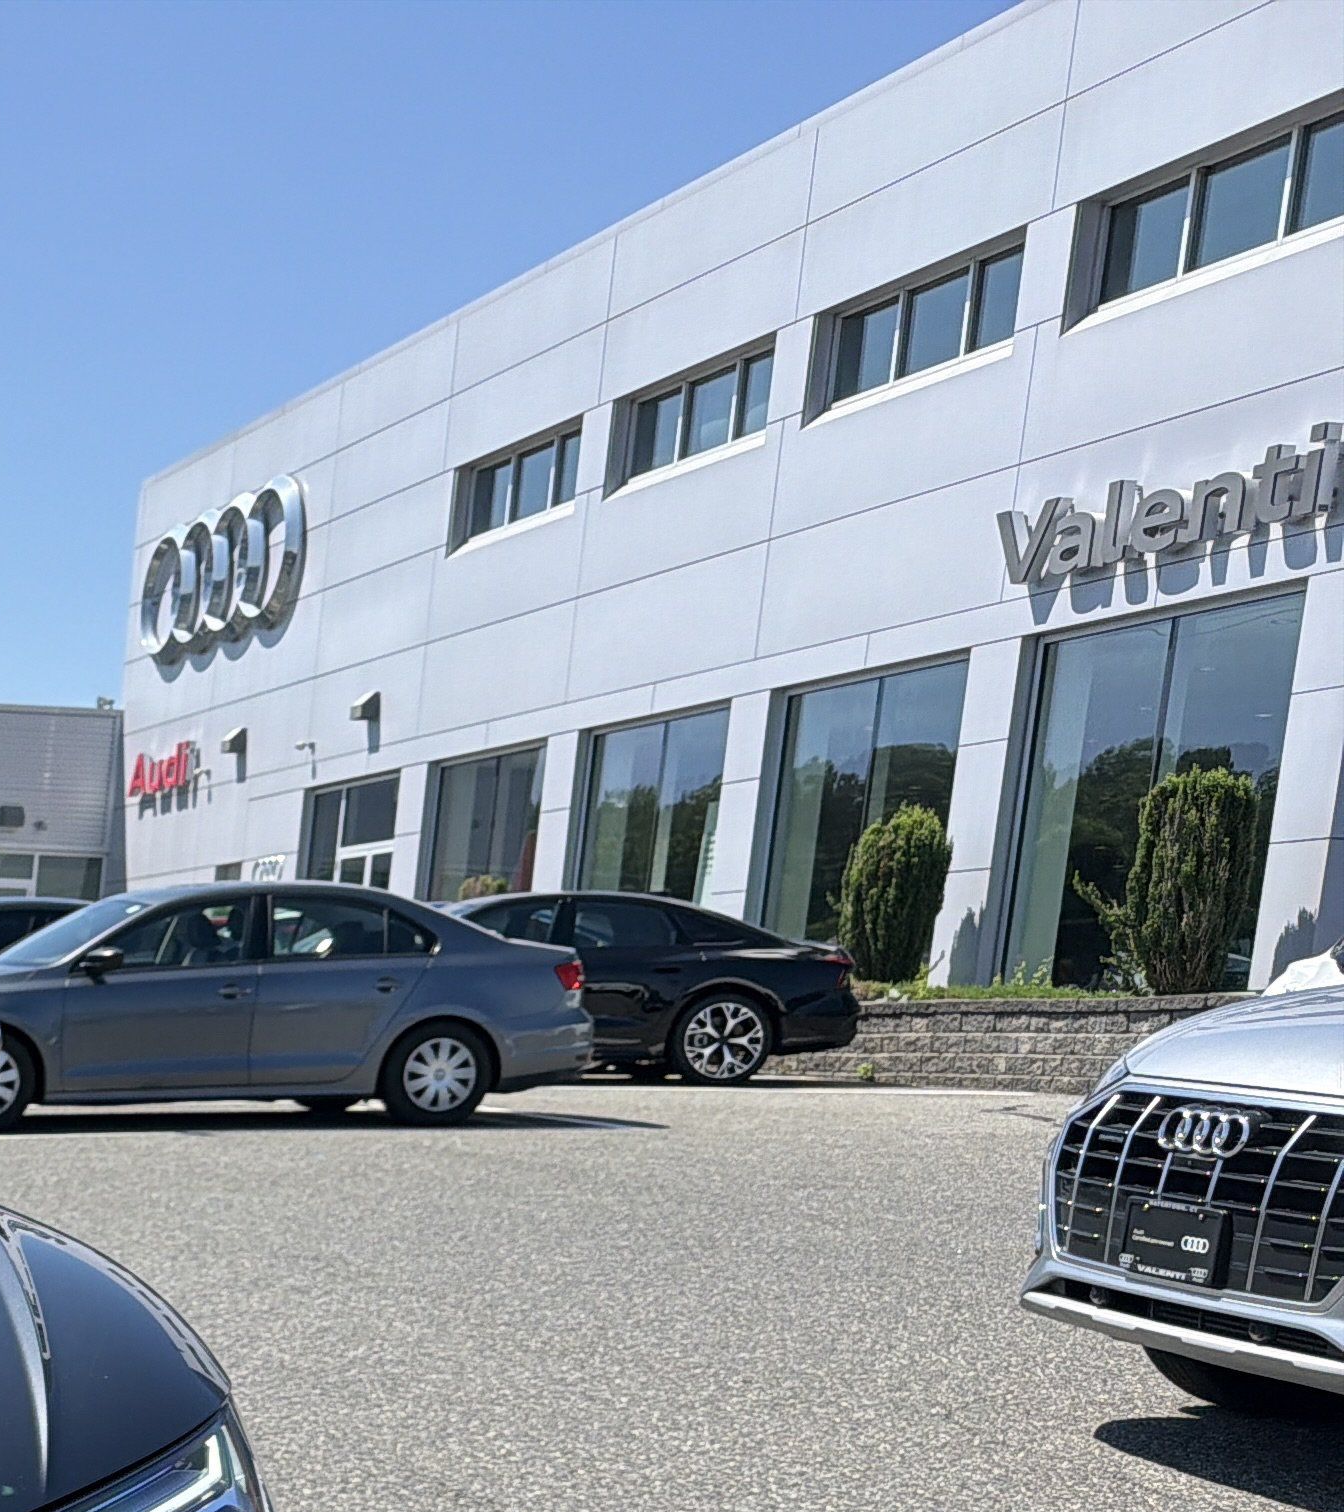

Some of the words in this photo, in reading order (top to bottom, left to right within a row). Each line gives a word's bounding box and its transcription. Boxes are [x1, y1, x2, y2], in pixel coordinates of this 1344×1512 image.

[997, 421, 1343, 584] Valenti
[128, 740, 192, 797] Audi
[1136, 1263, 1188, 1281] VALENTI
